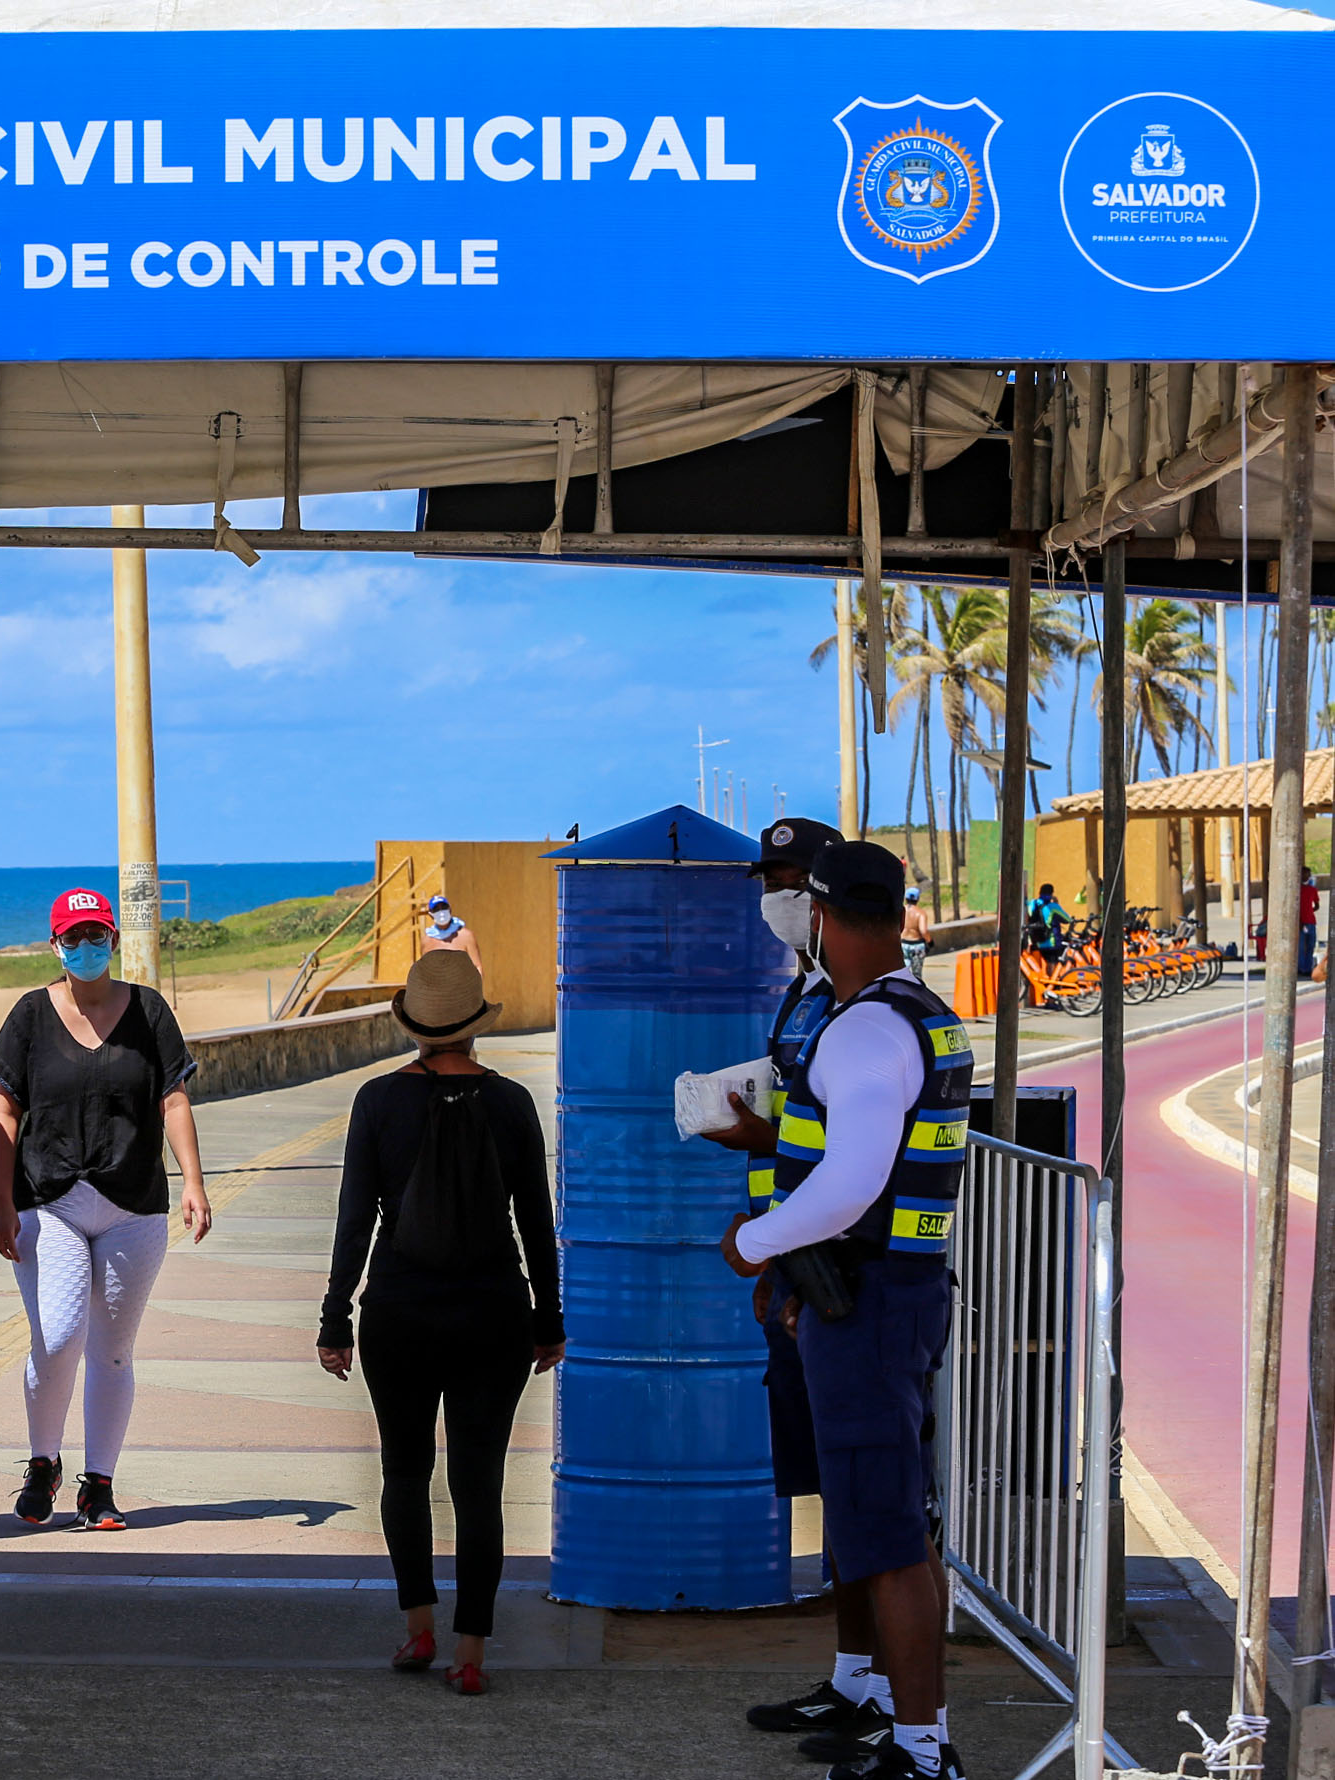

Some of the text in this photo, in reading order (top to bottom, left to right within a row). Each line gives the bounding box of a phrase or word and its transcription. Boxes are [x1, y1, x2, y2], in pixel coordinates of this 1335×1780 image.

[225, 115, 757, 182] MUNICIPAL
[866, 140, 967, 191] GUARDA CIVIL MUNICIPAL
[1092, 183, 1226, 207] SALVADOR
[1110, 211, 1206, 223] PREFEITURA
[887, 223, 946, 240] SALVADOR
[24, 242, 109, 289] DE
[130, 239, 498, 288] CONTROLE
[68, 893, 99, 911] RED
